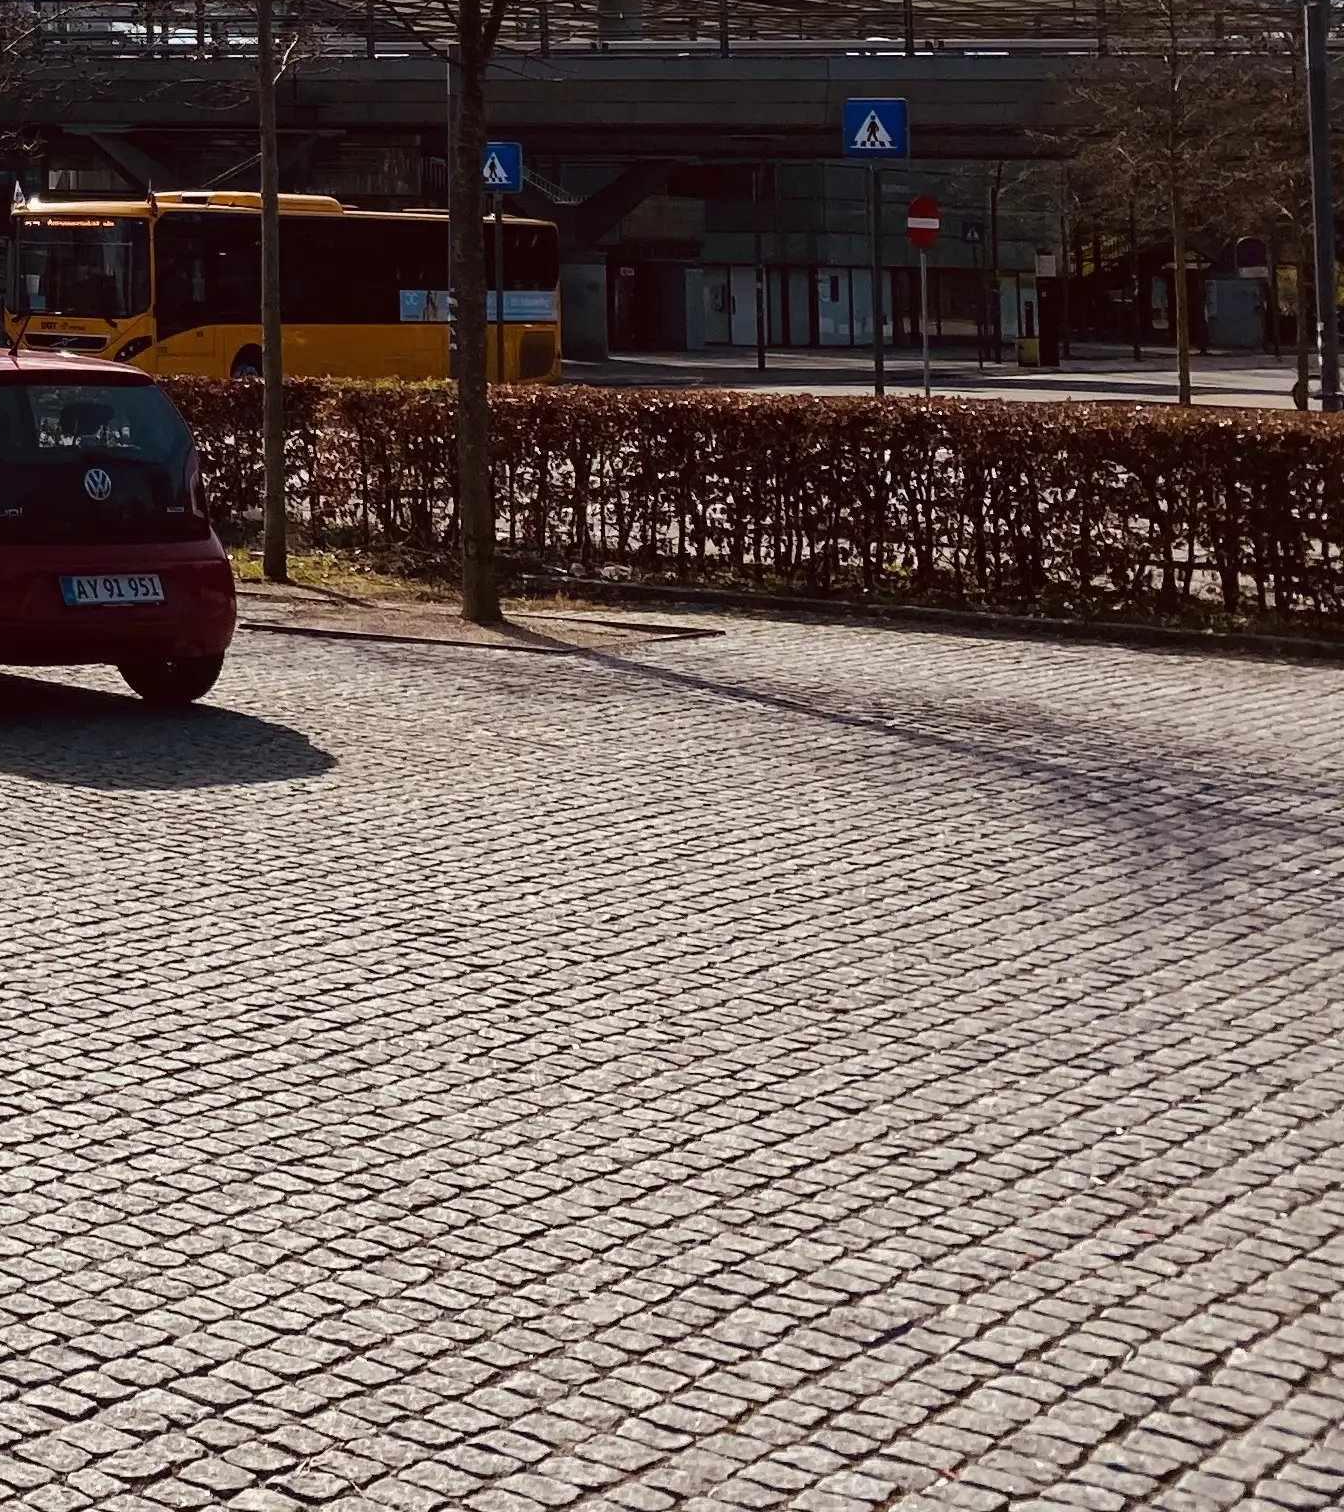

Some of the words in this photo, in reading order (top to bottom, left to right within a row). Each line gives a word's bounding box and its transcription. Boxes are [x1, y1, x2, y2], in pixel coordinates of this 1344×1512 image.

[77, 579, 98, 599] AY
[103, 578, 125, 598] 91
[128, 577, 160, 598] 951
